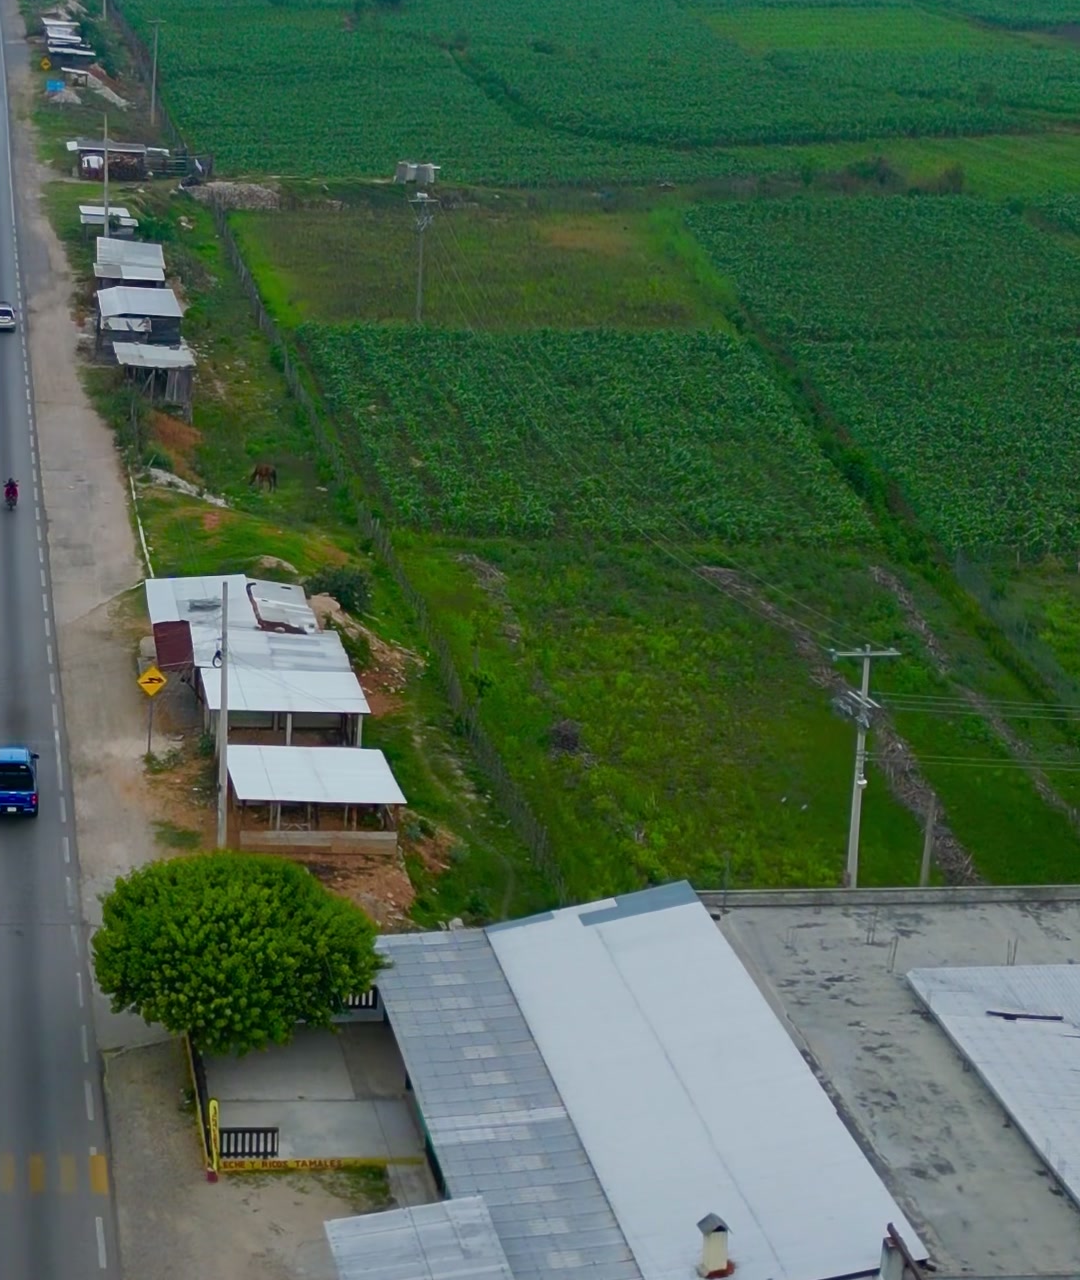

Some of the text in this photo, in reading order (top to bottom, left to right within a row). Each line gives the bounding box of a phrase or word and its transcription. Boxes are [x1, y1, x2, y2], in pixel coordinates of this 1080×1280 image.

[222, 1160, 245, 1169] ECHE
[250, 1160, 255, 1169] Y
[295, 1159, 343, 1169] TAMALES
